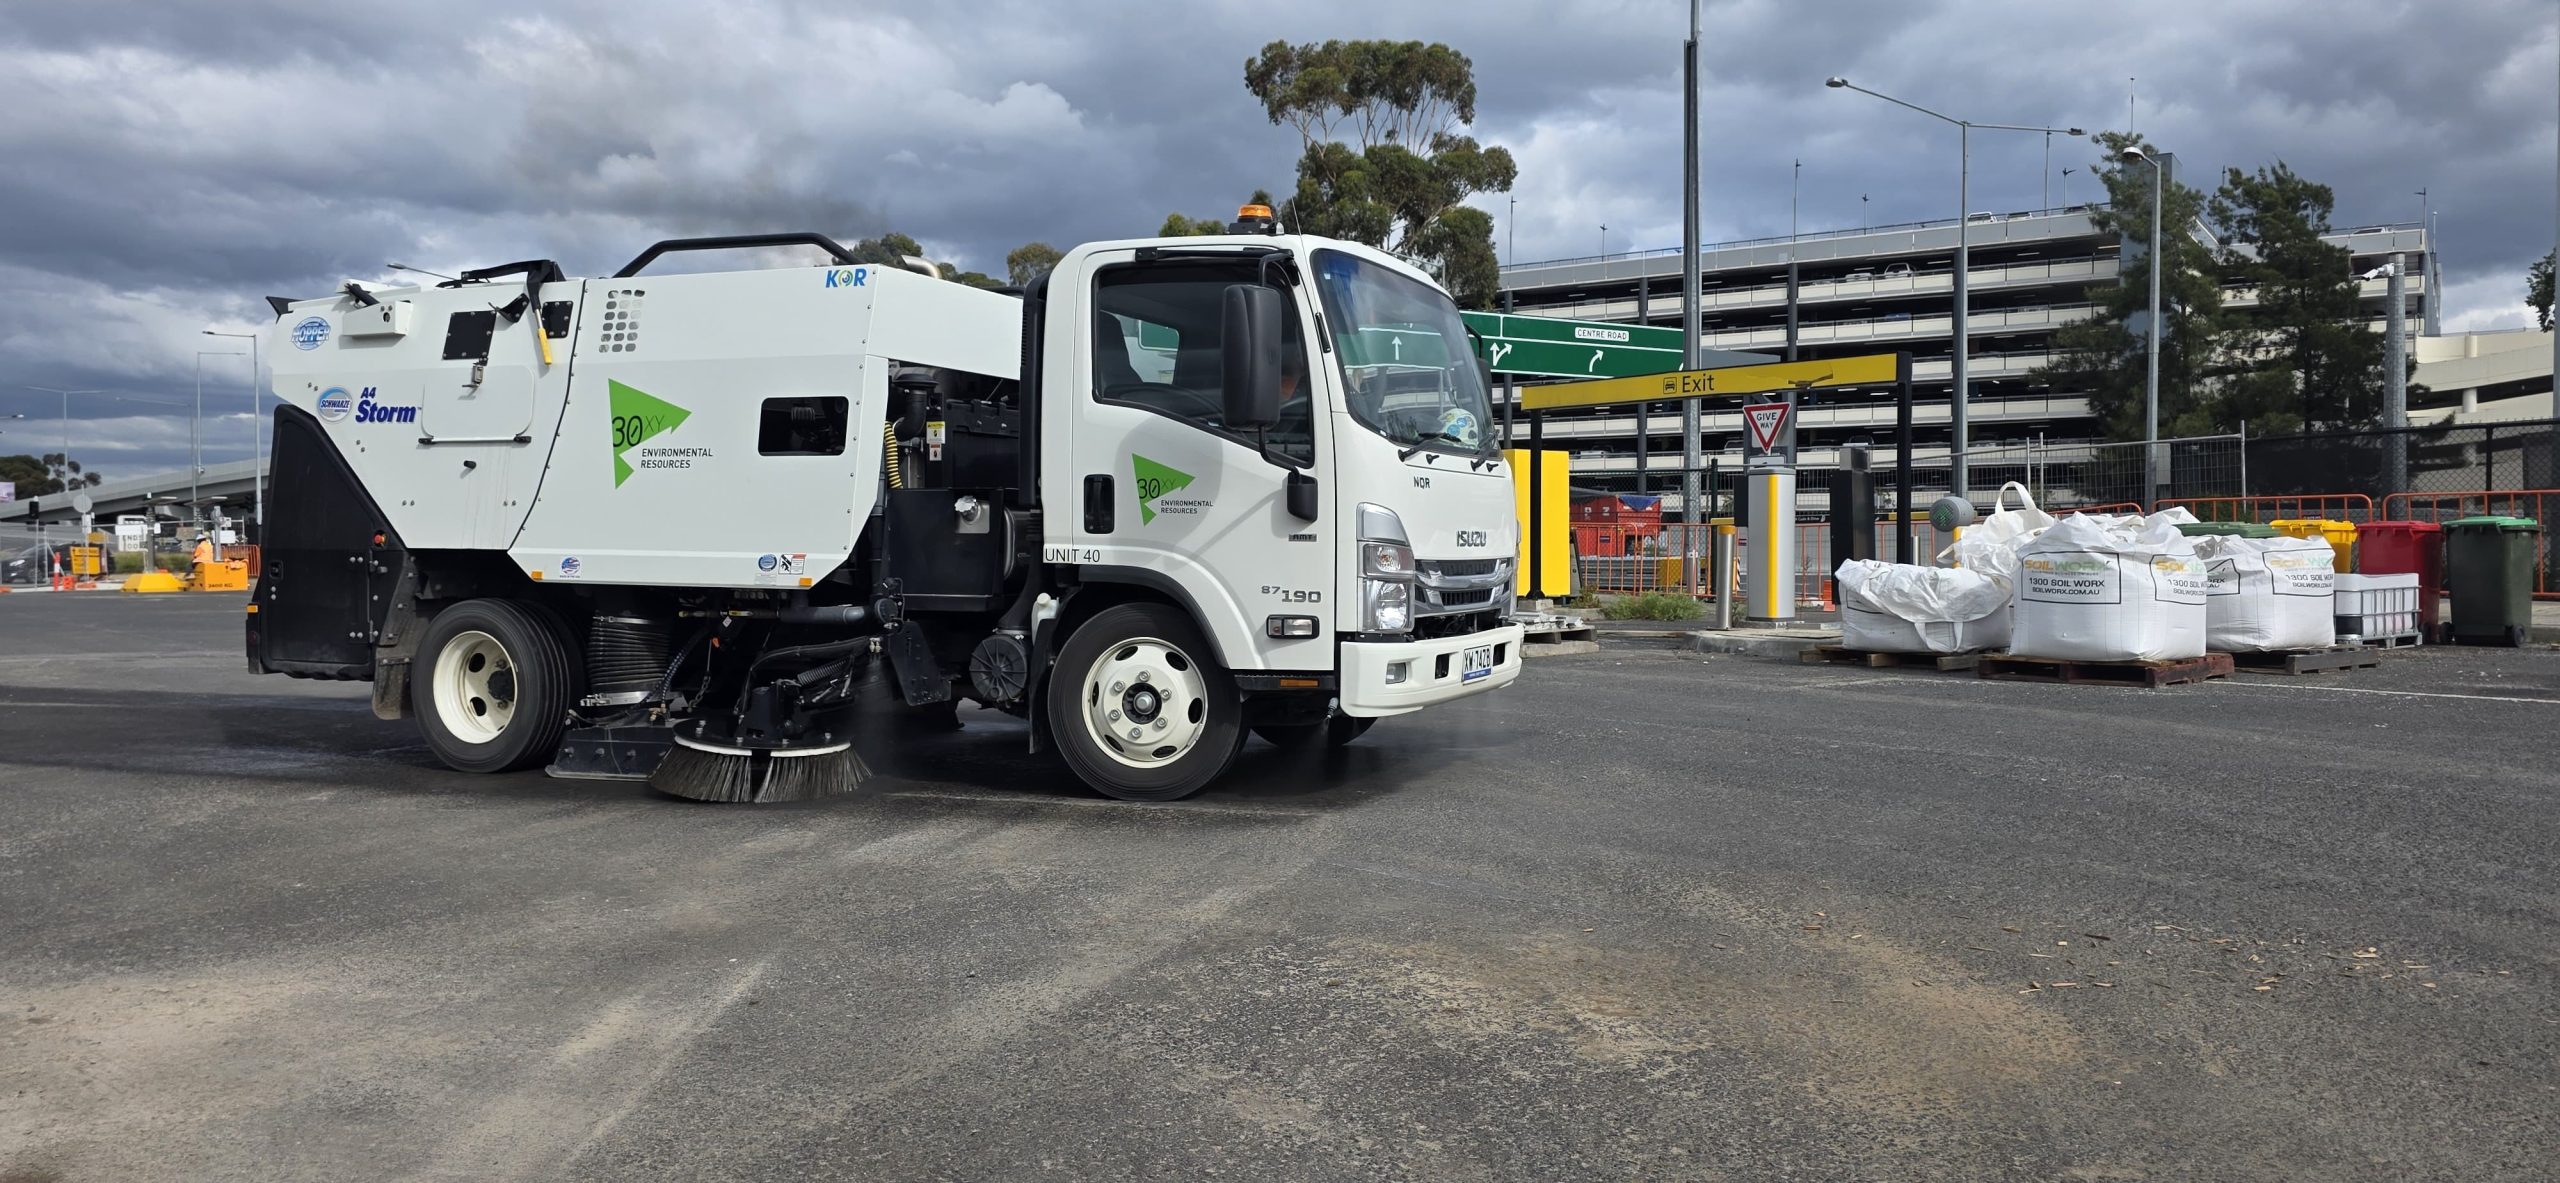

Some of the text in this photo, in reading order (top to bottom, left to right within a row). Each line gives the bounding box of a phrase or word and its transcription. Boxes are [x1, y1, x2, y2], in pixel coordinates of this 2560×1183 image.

[826, 268, 867, 288] KOR
[1577, 328, 1627, 340] CENTRE ROAD
[1682, 373, 1715, 393] Exit
[360, 387, 376, 399] A4
[320, 400, 350, 409] SCHWARZE
[355, 400, 417, 423] Storm
[1756, 412, 1777, 421] GIVE
[641, 448, 714, 457] ENVIRONMENTAL
[640, 459, 691, 469] RESOURCES
[1413, 476, 1431, 489] NQR
[1160, 499, 1214, 507] ENVIRONMENTAL
[1160, 507, 1198, 515] RESOURCES
[1456, 531, 1487, 547] ISUZU
[1045, 548, 1100, 562] UNIT 40
[2029, 577, 2049, 586] 1300
[2051, 579, 2071, 587] SOIL
[2032, 586, 2100, 595] SOILWORX.COM.AU
